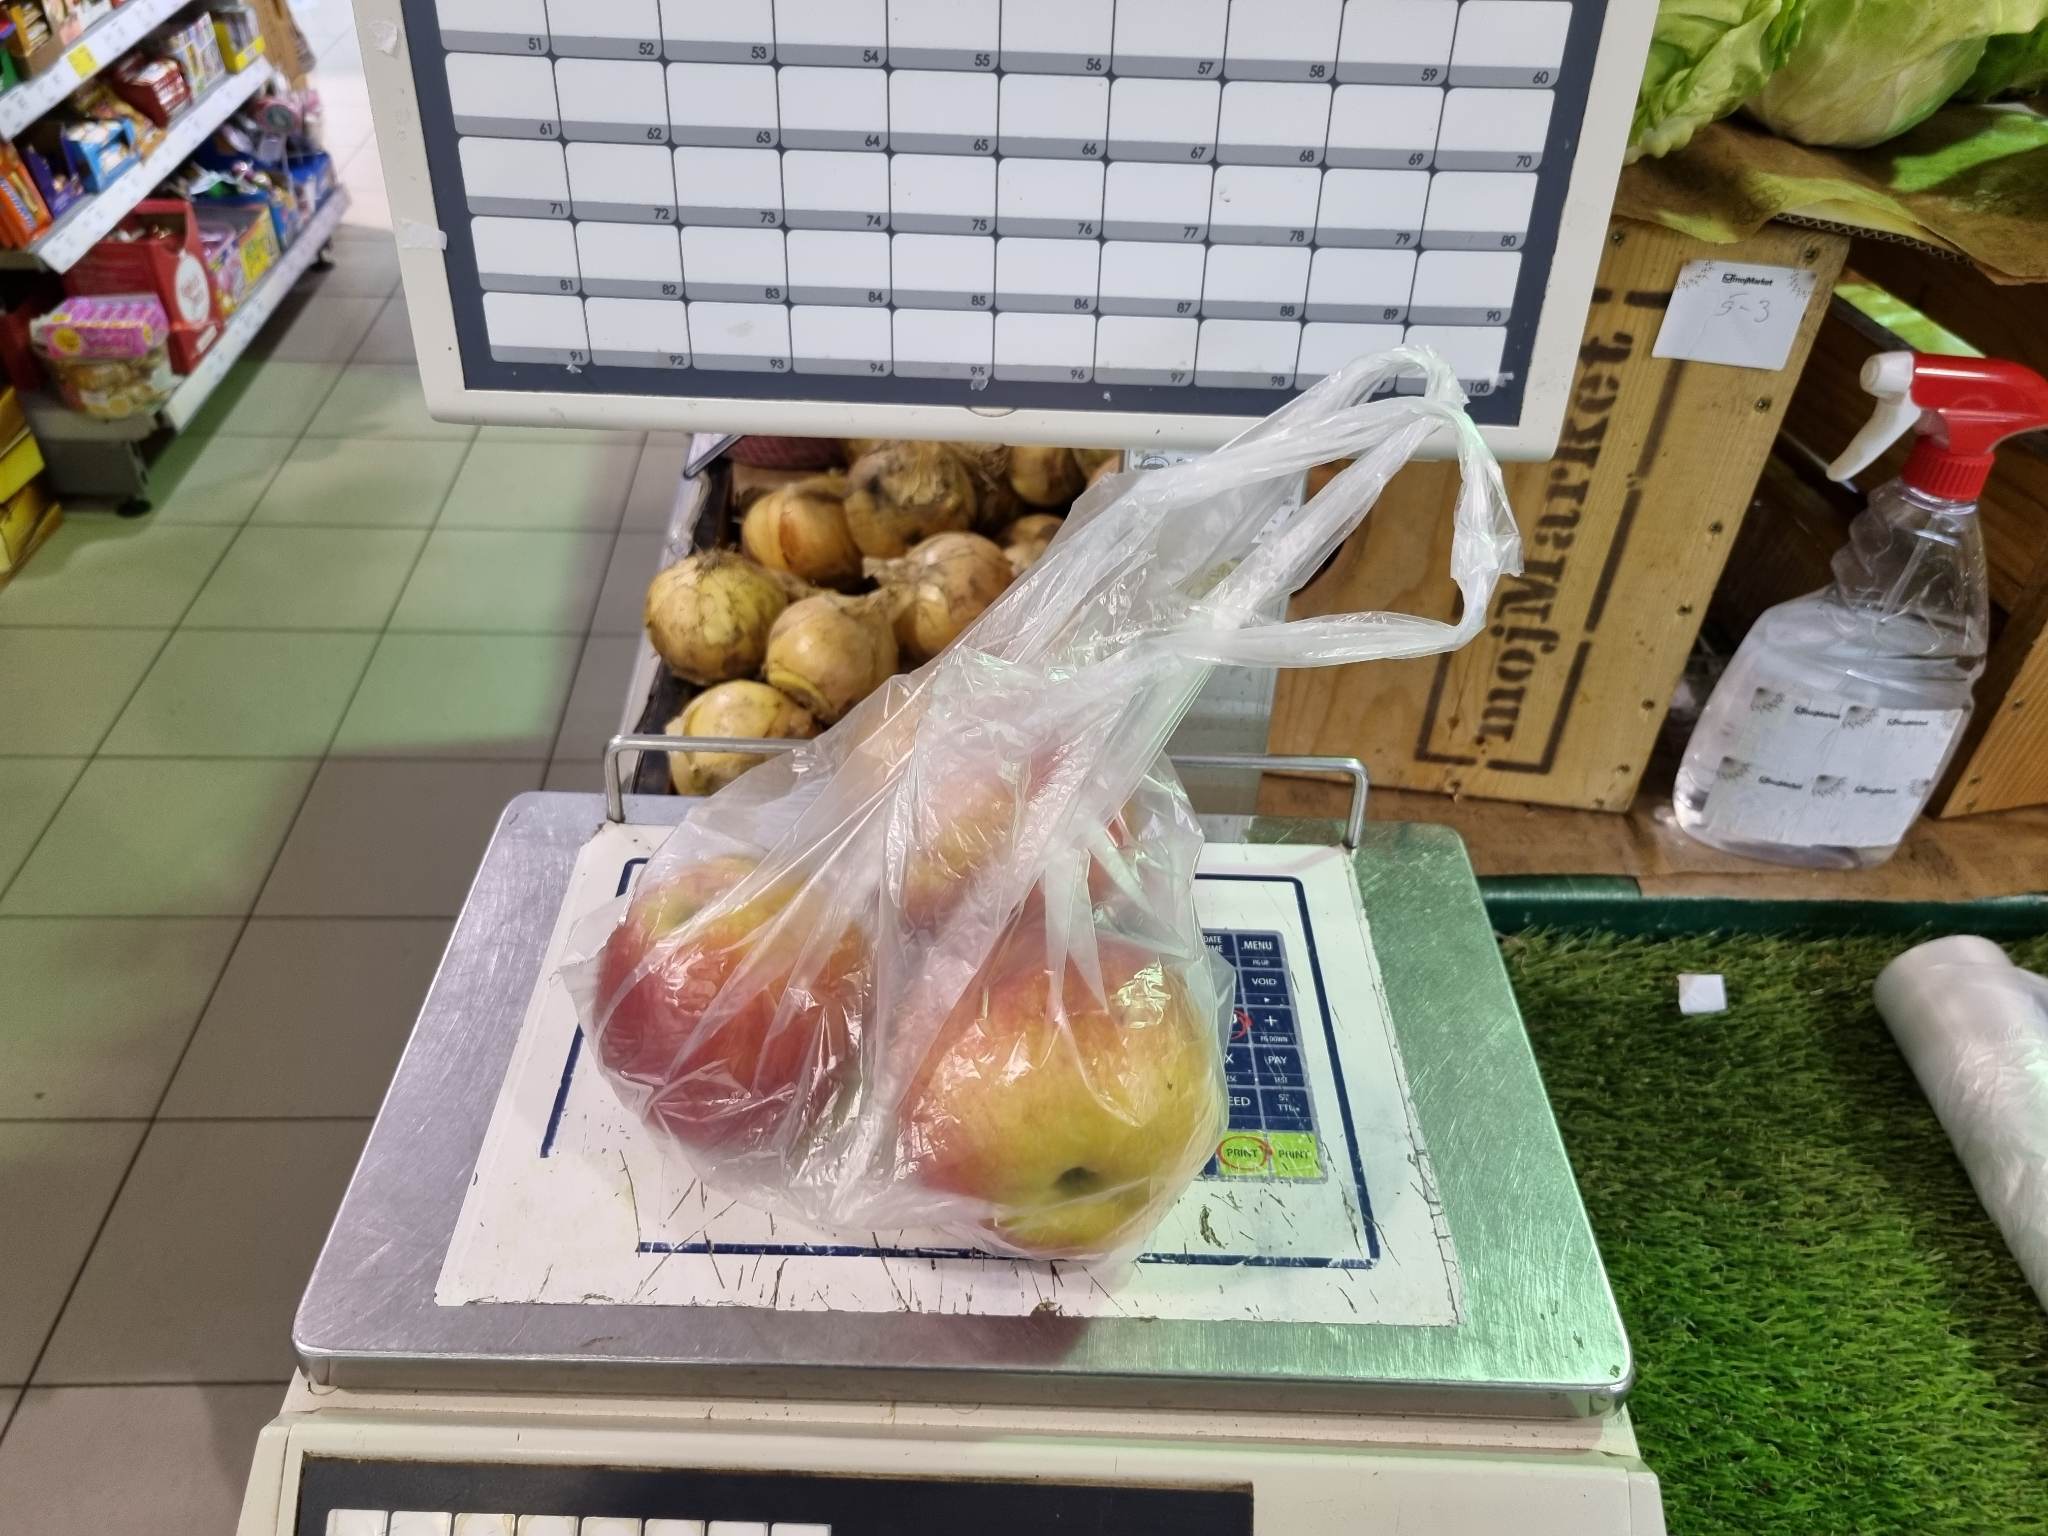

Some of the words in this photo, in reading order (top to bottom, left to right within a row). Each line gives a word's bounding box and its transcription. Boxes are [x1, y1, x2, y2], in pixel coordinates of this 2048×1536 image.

[528, 37, 542, 50] 51
[638, 42, 655, 55] 52
[751, 46, 767, 59] 53
[863, 50, 879, 63] 54
[974, 53, 990, 67] 55
[1086, 58, 1102, 71] 56
[1197, 61, 1214, 74] 57
[1309, 64, 1325, 78] 58
[1421, 68, 1438, 81] 59
[1533, 71, 1549, 84] 60
[540, 123, 552, 135] 61
[647, 128, 662, 140] 62
[756, 131, 771, 144] 63
[865, 134, 880, 147] 64
[974, 139, 988, 151] 65
[1082, 142, 1097, 155] 66
[1191, 146, 1206, 159] 67
[1299, 150, 1314, 162] 68
[1408, 153, 1424, 165] 69
[1516, 155, 1532, 168] 70
[550, 202, 563, 214] 71
[654, 208, 670, 220] 72
[760, 211, 776, 224] 73
[867, 215, 881, 227] 74
[972, 219, 987, 231] 75
[1078, 222, 1092, 235] 76
[1184, 226, 1199, 239] 77
[1290, 230, 1304, 242] 78
[1395, 232, 1411, 245] 79
[1500, 235, 1516, 247] 80
[560, 280, 573, 290] 81
[662, 284, 677, 295] 82
[765, 288, 780, 299] 83
[868, 291, 883, 303] 84
[971, 295, 986, 306] 85
[1074, 298, 1088, 310] 86
[1177, 302, 1192, 313] 87
[1280, 305, 1295, 317] 88
[1383, 308, 1398, 320] 89
[1487, 310, 1501, 322] 90
[570, 351, 583, 361] 91
[669, 355, 684, 365] 92
[770, 359, 784, 369] 93
[870, 363, 884, 373] 94
[971, 366, 984, 376] 95
[1071, 369, 1085, 380] 96
[1171, 372, 1185, 383] 97
[1271, 376, 1285, 387] 98
[1469, 382, 1489, 393] 100
[1481, 330, 1633, 742] mojMarket
[1243, 940, 1273, 950] MENU
[1251, 977, 1277, 986] VOID
[1267, 1056, 1287, 1064] PAY
[1226, 1149, 1257, 1158] PRINT
[1278, 1149, 1309, 1158] PRINT
